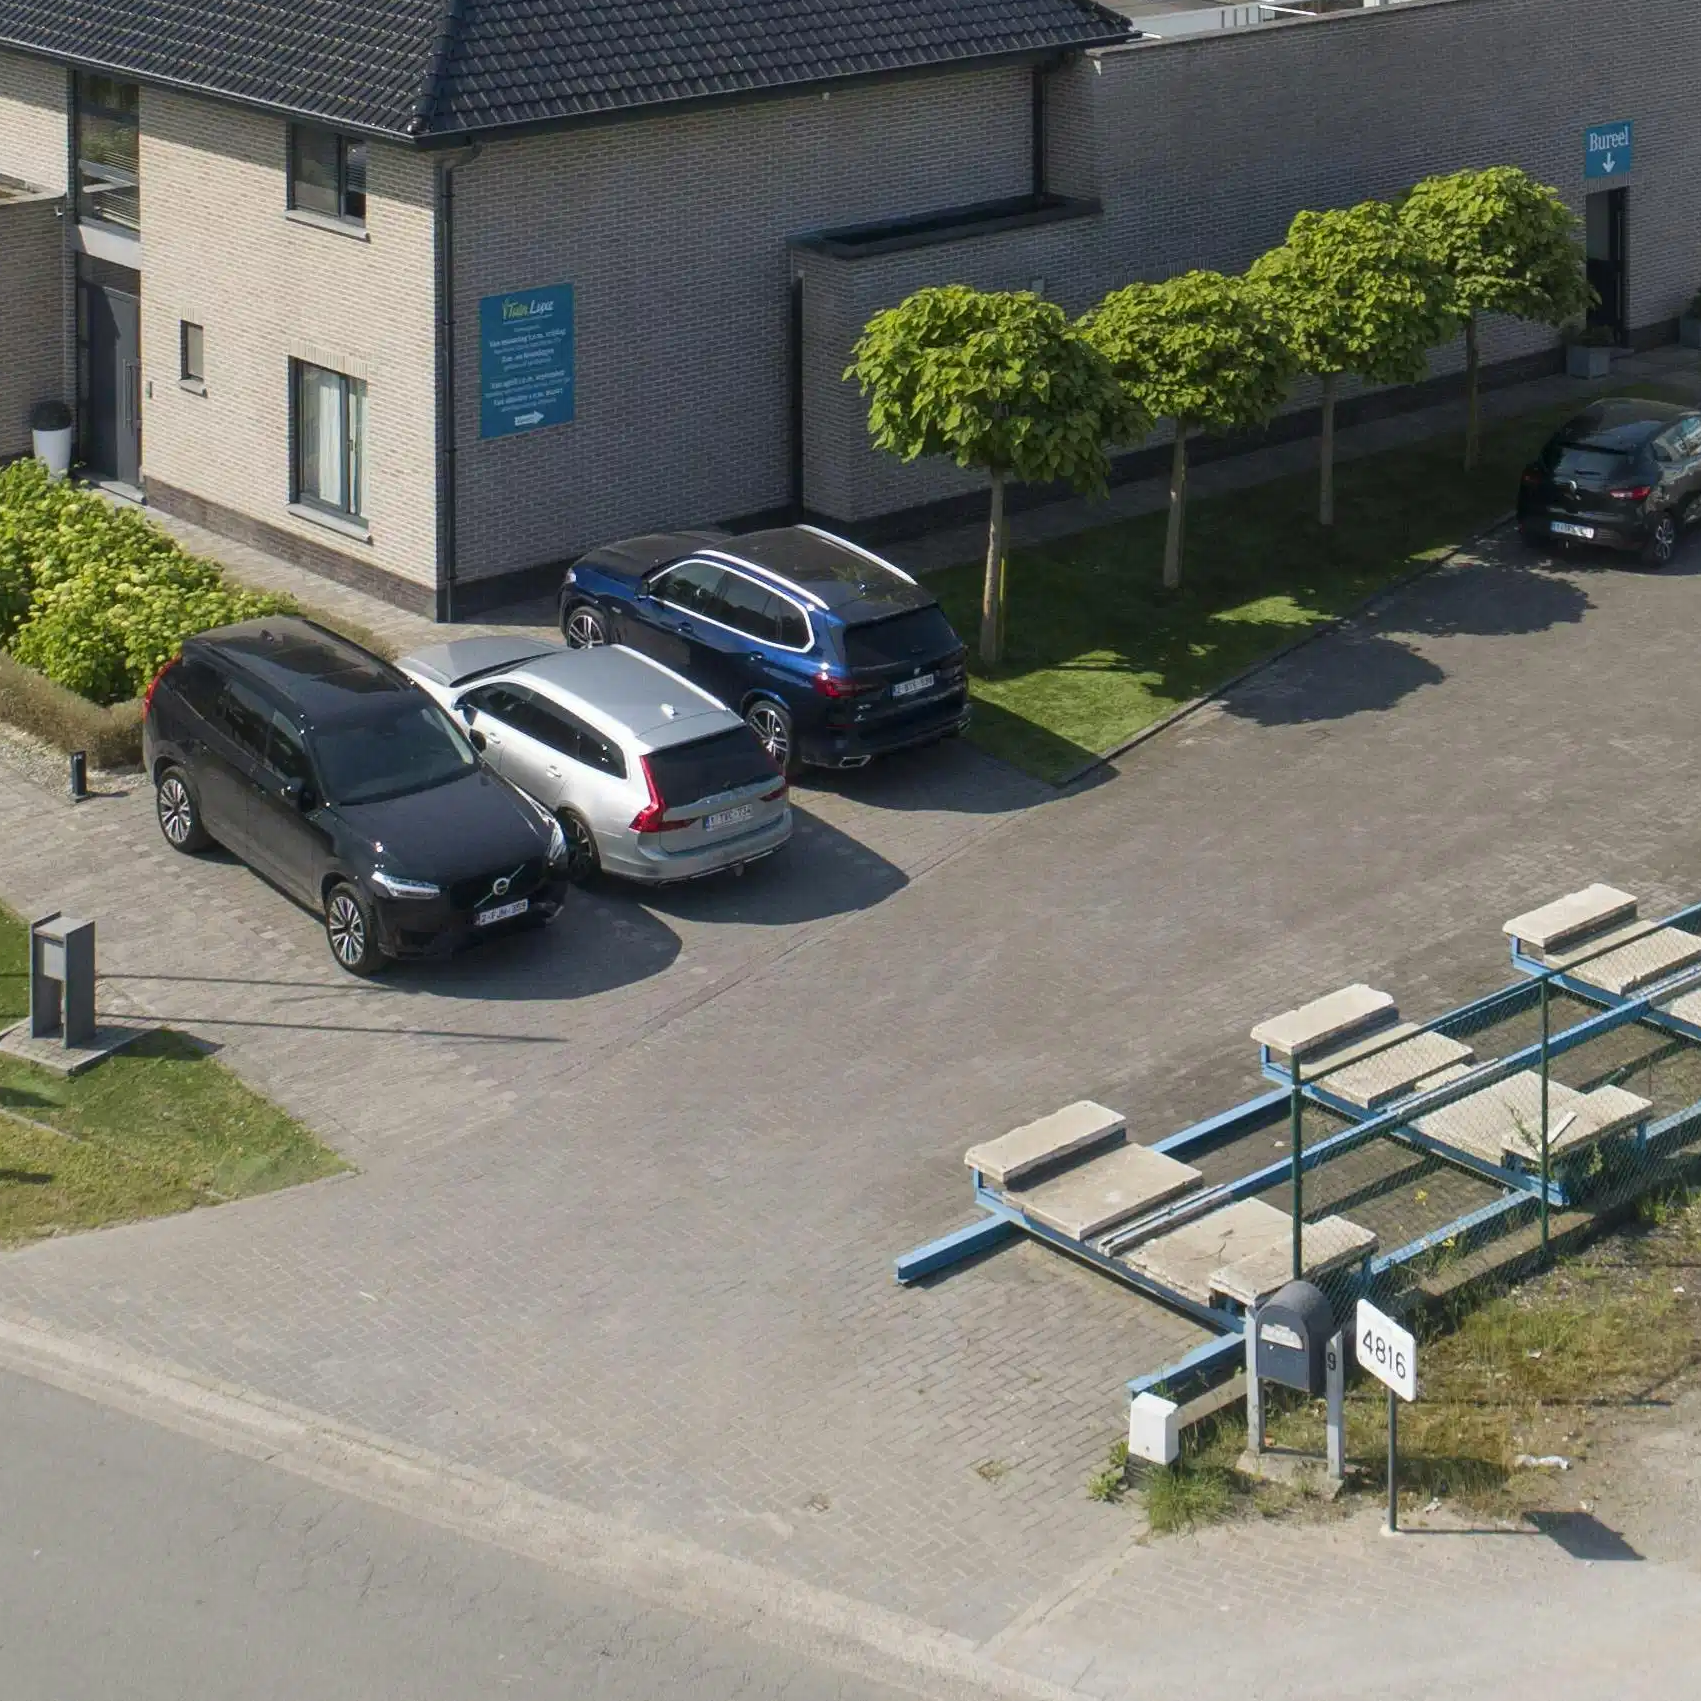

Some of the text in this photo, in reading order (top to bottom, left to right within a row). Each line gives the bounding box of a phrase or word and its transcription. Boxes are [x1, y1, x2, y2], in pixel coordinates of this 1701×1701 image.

[1589, 125, 1629, 152] Bureel
[1327, 1351, 1337, 1371] 9
[1362, 1329, 1406, 1380] 4816
